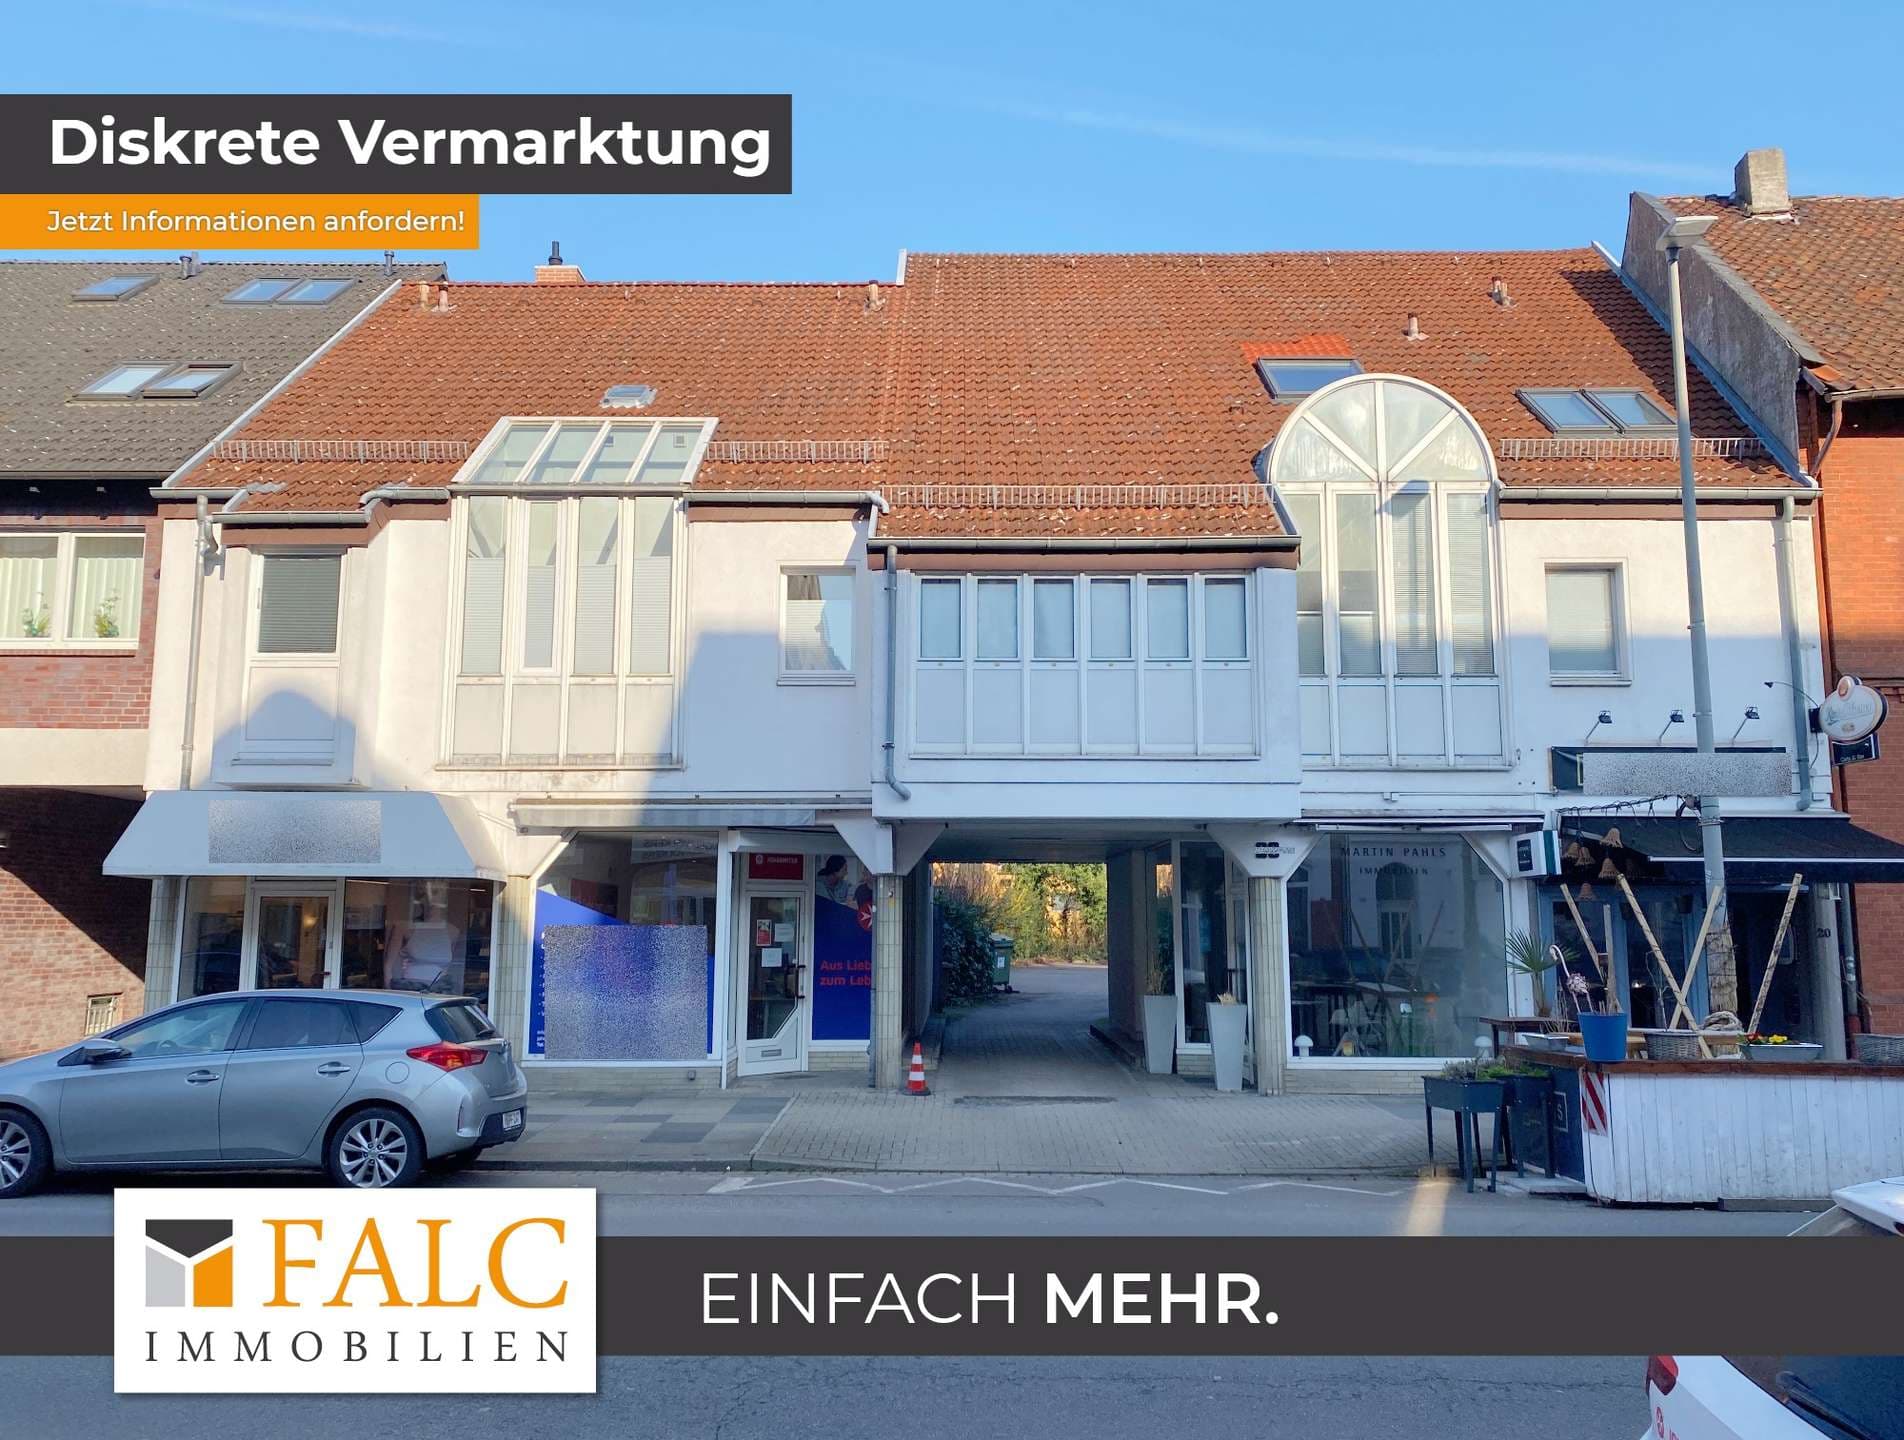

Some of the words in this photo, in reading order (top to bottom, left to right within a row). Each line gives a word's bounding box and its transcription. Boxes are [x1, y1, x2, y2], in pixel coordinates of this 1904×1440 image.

[1341, 847, 1394, 857] MARTIN
[1403, 847, 1447, 857] PAHLS
[1816, 928, 1831, 938] 20
[820, 960, 843, 971] Aus
[847, 960, 872, 971] Lieb
[820, 977, 845, 986] zum
[850, 975, 872, 986] Leb
